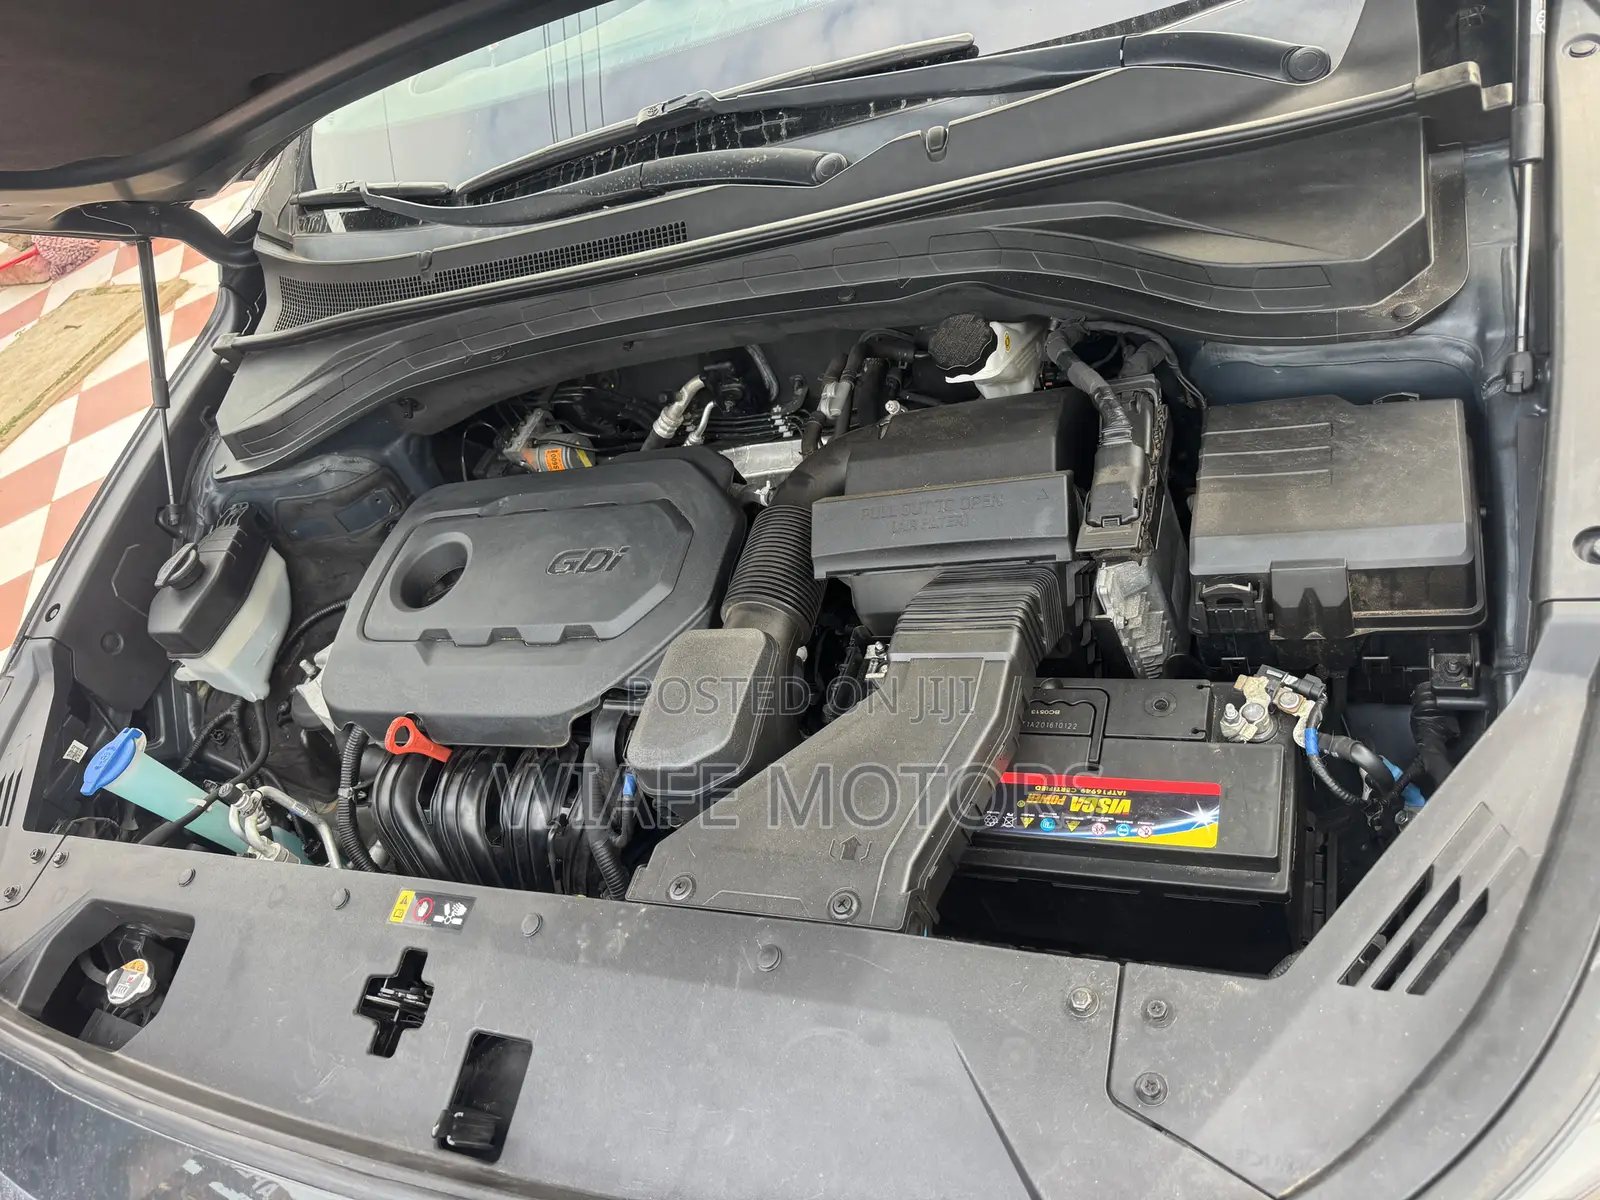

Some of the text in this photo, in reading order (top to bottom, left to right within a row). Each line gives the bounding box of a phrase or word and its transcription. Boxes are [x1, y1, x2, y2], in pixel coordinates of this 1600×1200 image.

[901, 500, 931, 516] OUT
[960, 494, 1004, 511] OPEN
[1034, 785, 1127, 796] IATF16949 CERTIFIED
[1026, 793, 1067, 805] POWER
[1069, 796, 1132, 815] VISCA
